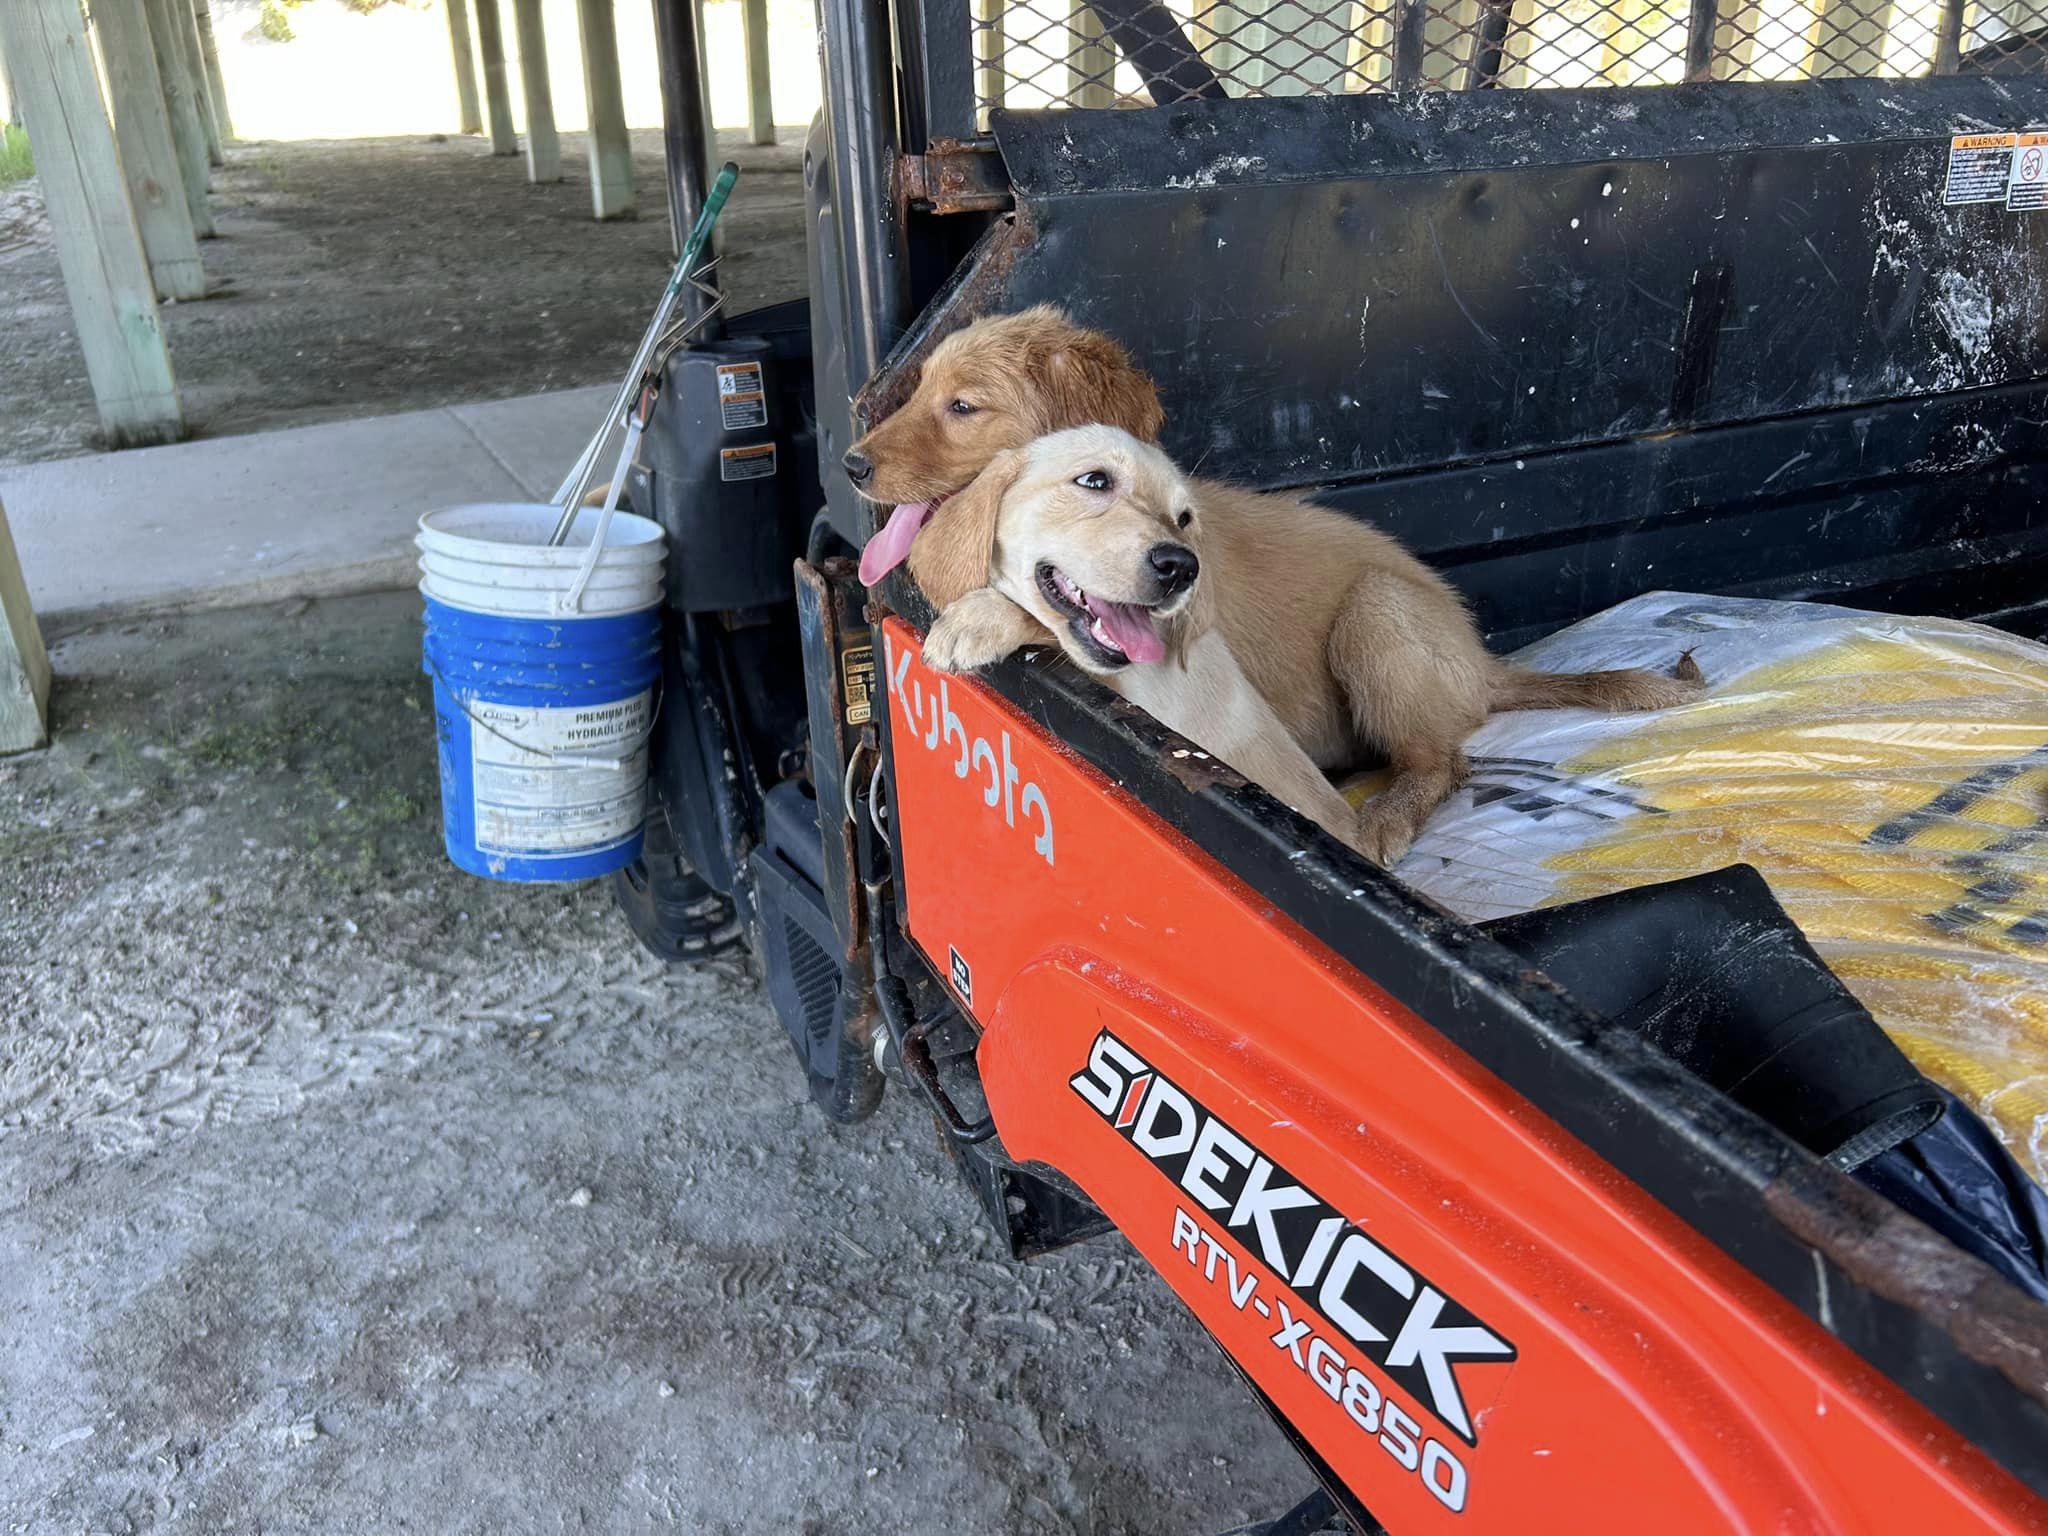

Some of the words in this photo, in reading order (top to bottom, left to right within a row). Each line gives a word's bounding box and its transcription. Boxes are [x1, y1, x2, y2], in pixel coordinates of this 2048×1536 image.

[1970, 136, 2007, 146] WARNING
[576, 706, 623, 724] PREMIUM
[568, 722, 624, 741] HYDRAULIC
[883, 633, 1054, 866] Kubota
[955, 956, 966, 978] NO
[953, 967, 970, 995] STEP
[1070, 1034, 1513, 1440] SIDEKICK
[1171, 1205, 1469, 1513] RTV-XG850
